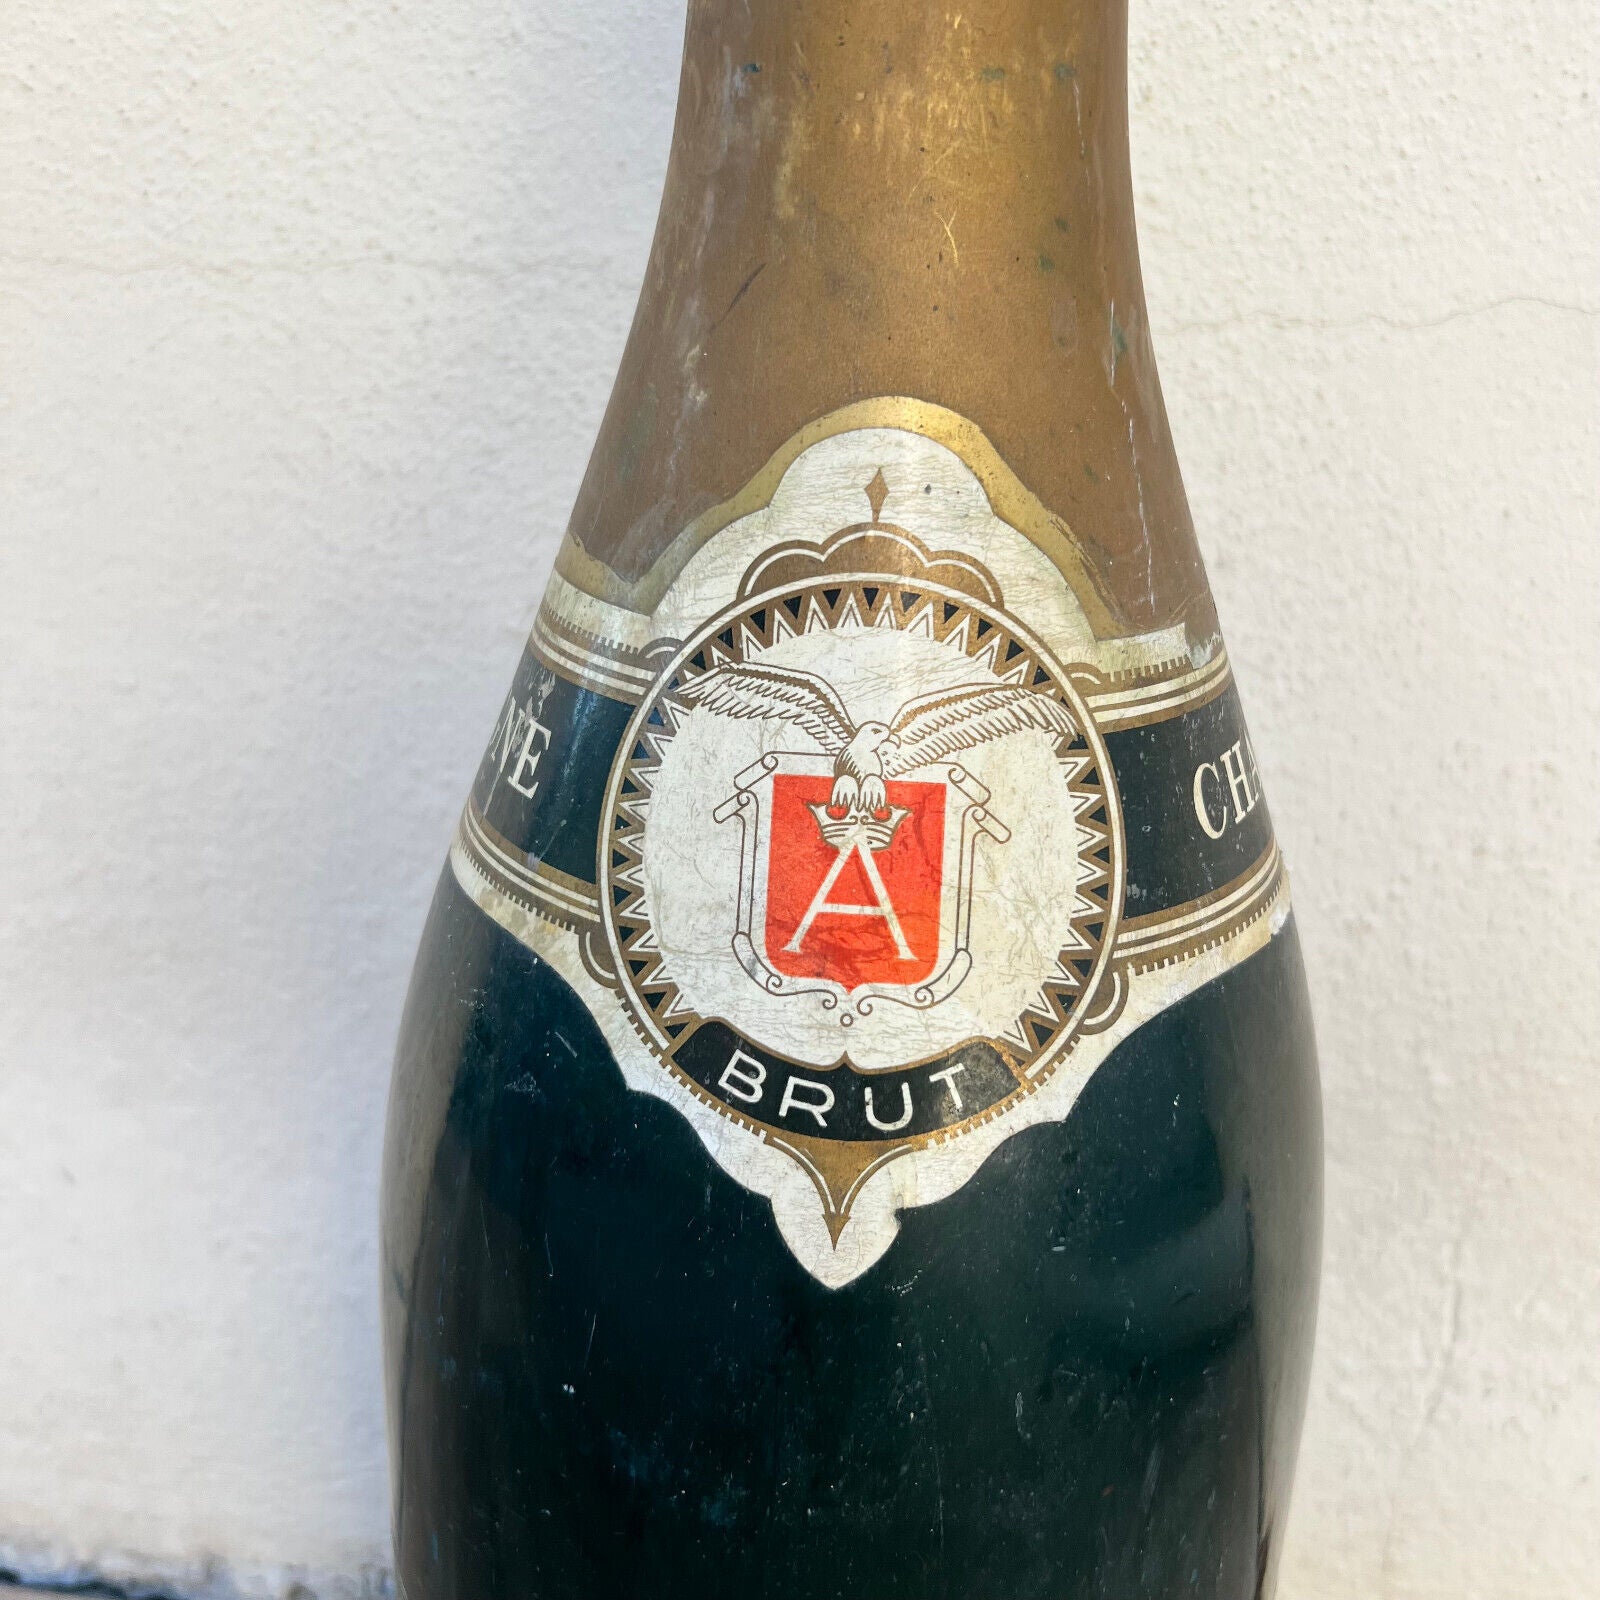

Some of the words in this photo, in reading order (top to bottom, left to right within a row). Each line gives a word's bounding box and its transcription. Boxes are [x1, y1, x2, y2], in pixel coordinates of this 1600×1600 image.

[489, 690, 551, 799] NE
[781, 838, 919, 961] A
[717, 1049, 965, 1131] BRUT
